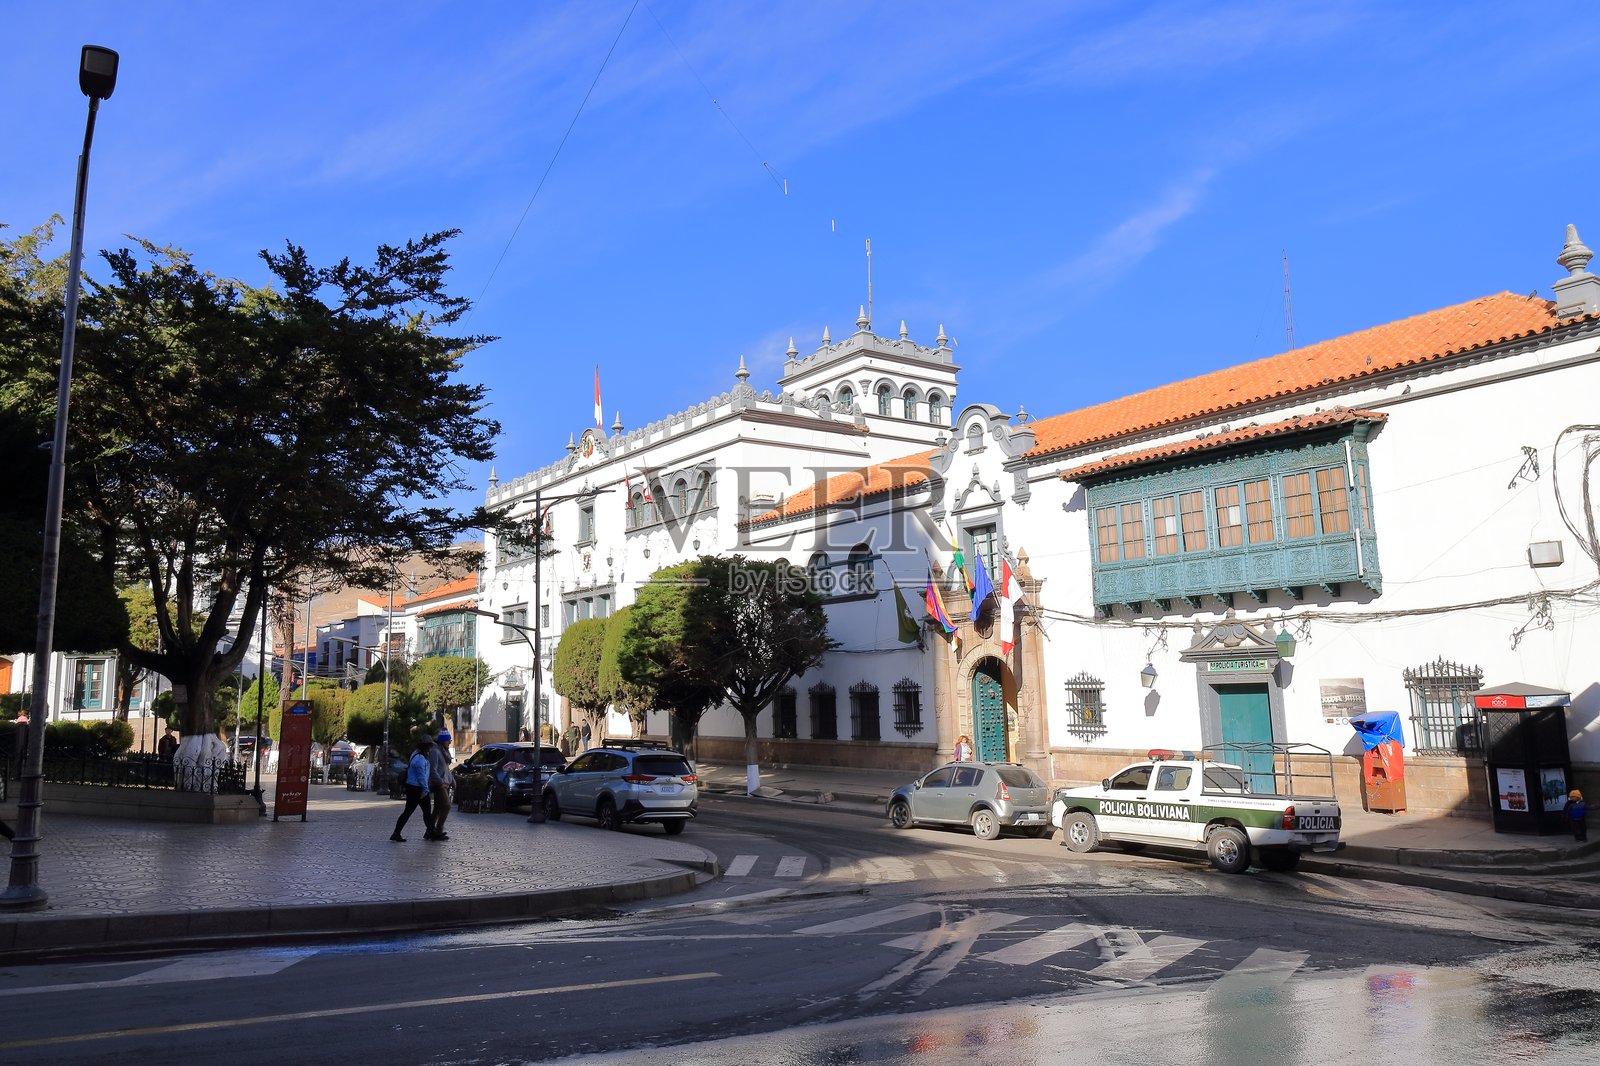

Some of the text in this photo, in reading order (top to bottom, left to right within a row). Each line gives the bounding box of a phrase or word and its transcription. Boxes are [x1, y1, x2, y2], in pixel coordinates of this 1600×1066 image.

[1100, 801, 1190, 820] POLICIA BOLIVIANA
[1299, 816, 1335, 830] POLICIA
